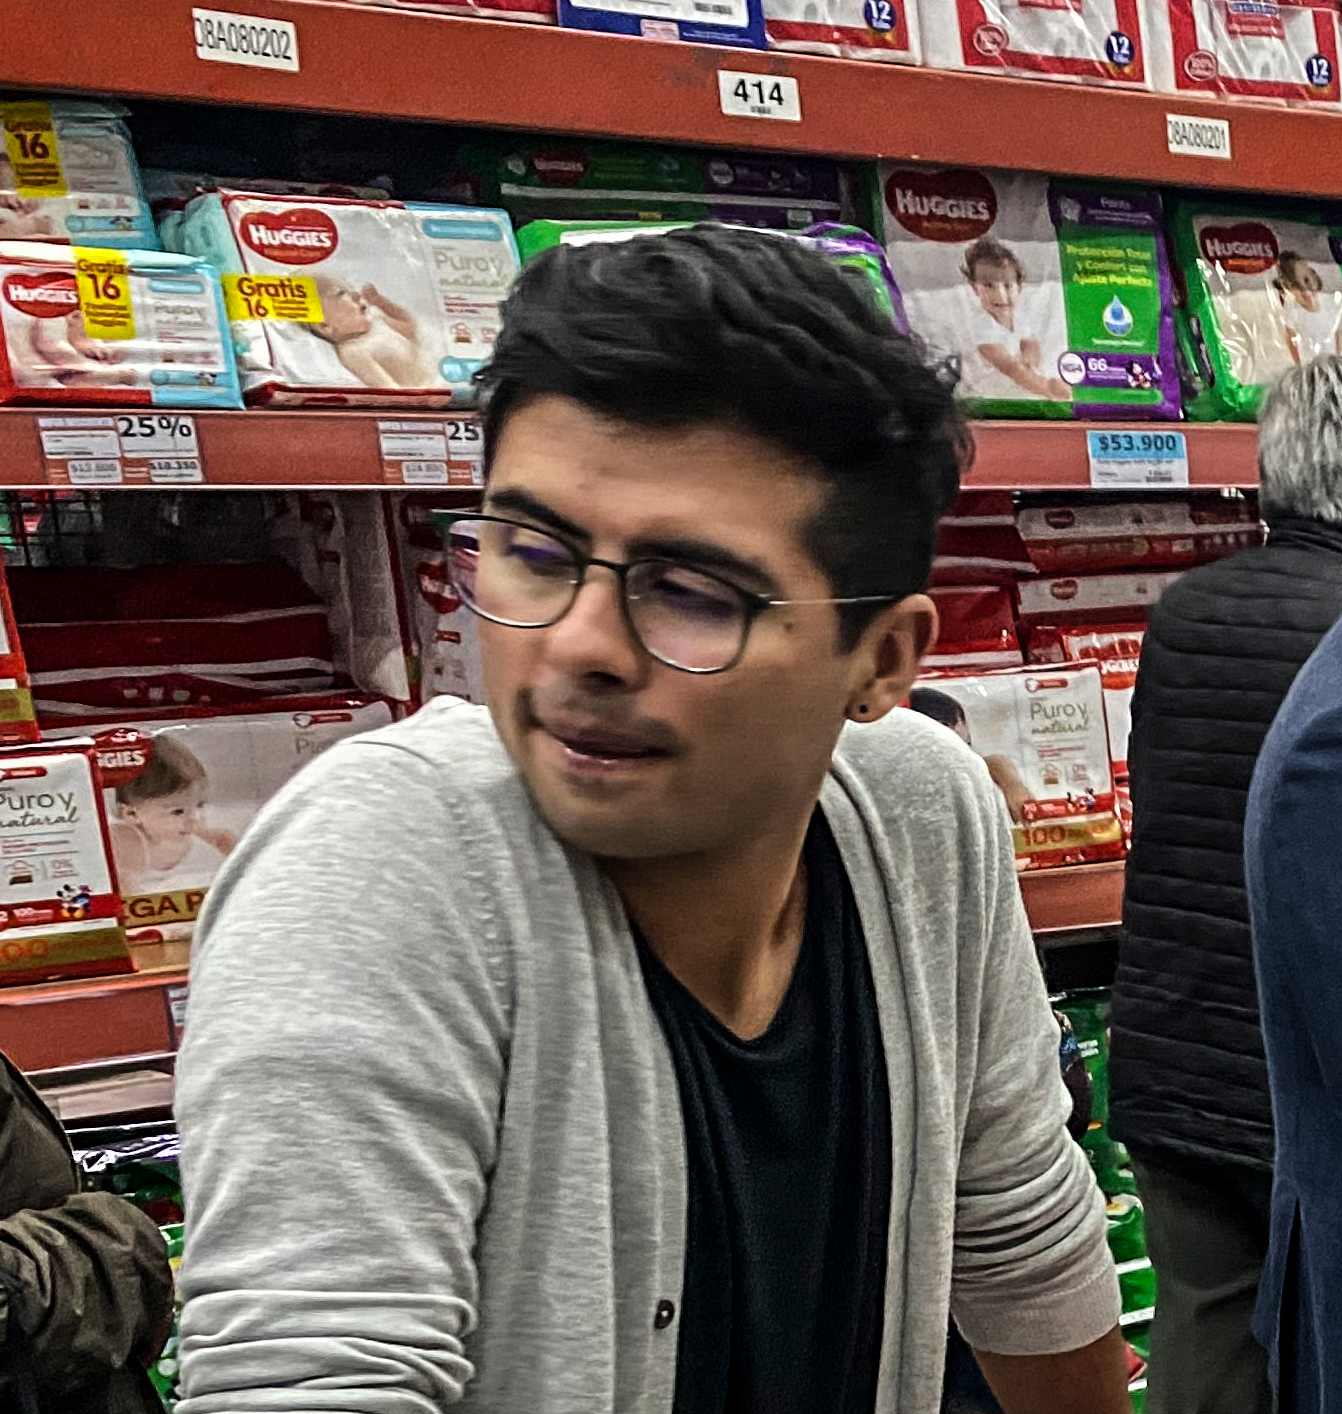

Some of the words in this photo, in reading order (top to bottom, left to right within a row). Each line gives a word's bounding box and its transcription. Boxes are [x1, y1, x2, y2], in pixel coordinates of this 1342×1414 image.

[869, 0, 893, 21] 12
[1110, 32, 1130, 55] 12
[1310, 58, 1329, 77] 12
[733, 79, 784, 106] 414
[15, 133, 50, 160] 16
[895, 188, 990, 222] HUGGIES
[249, 224, 332, 248] HUGGIES
[1205, 237, 1273, 260] HUGGIES
[86, 274, 121, 301] 16
[237, 277, 307, 300] Gratis
[245, 298, 269, 319] 16
[119, 416, 192, 439] 25%
[1097, 433, 1177, 453] $53.900
